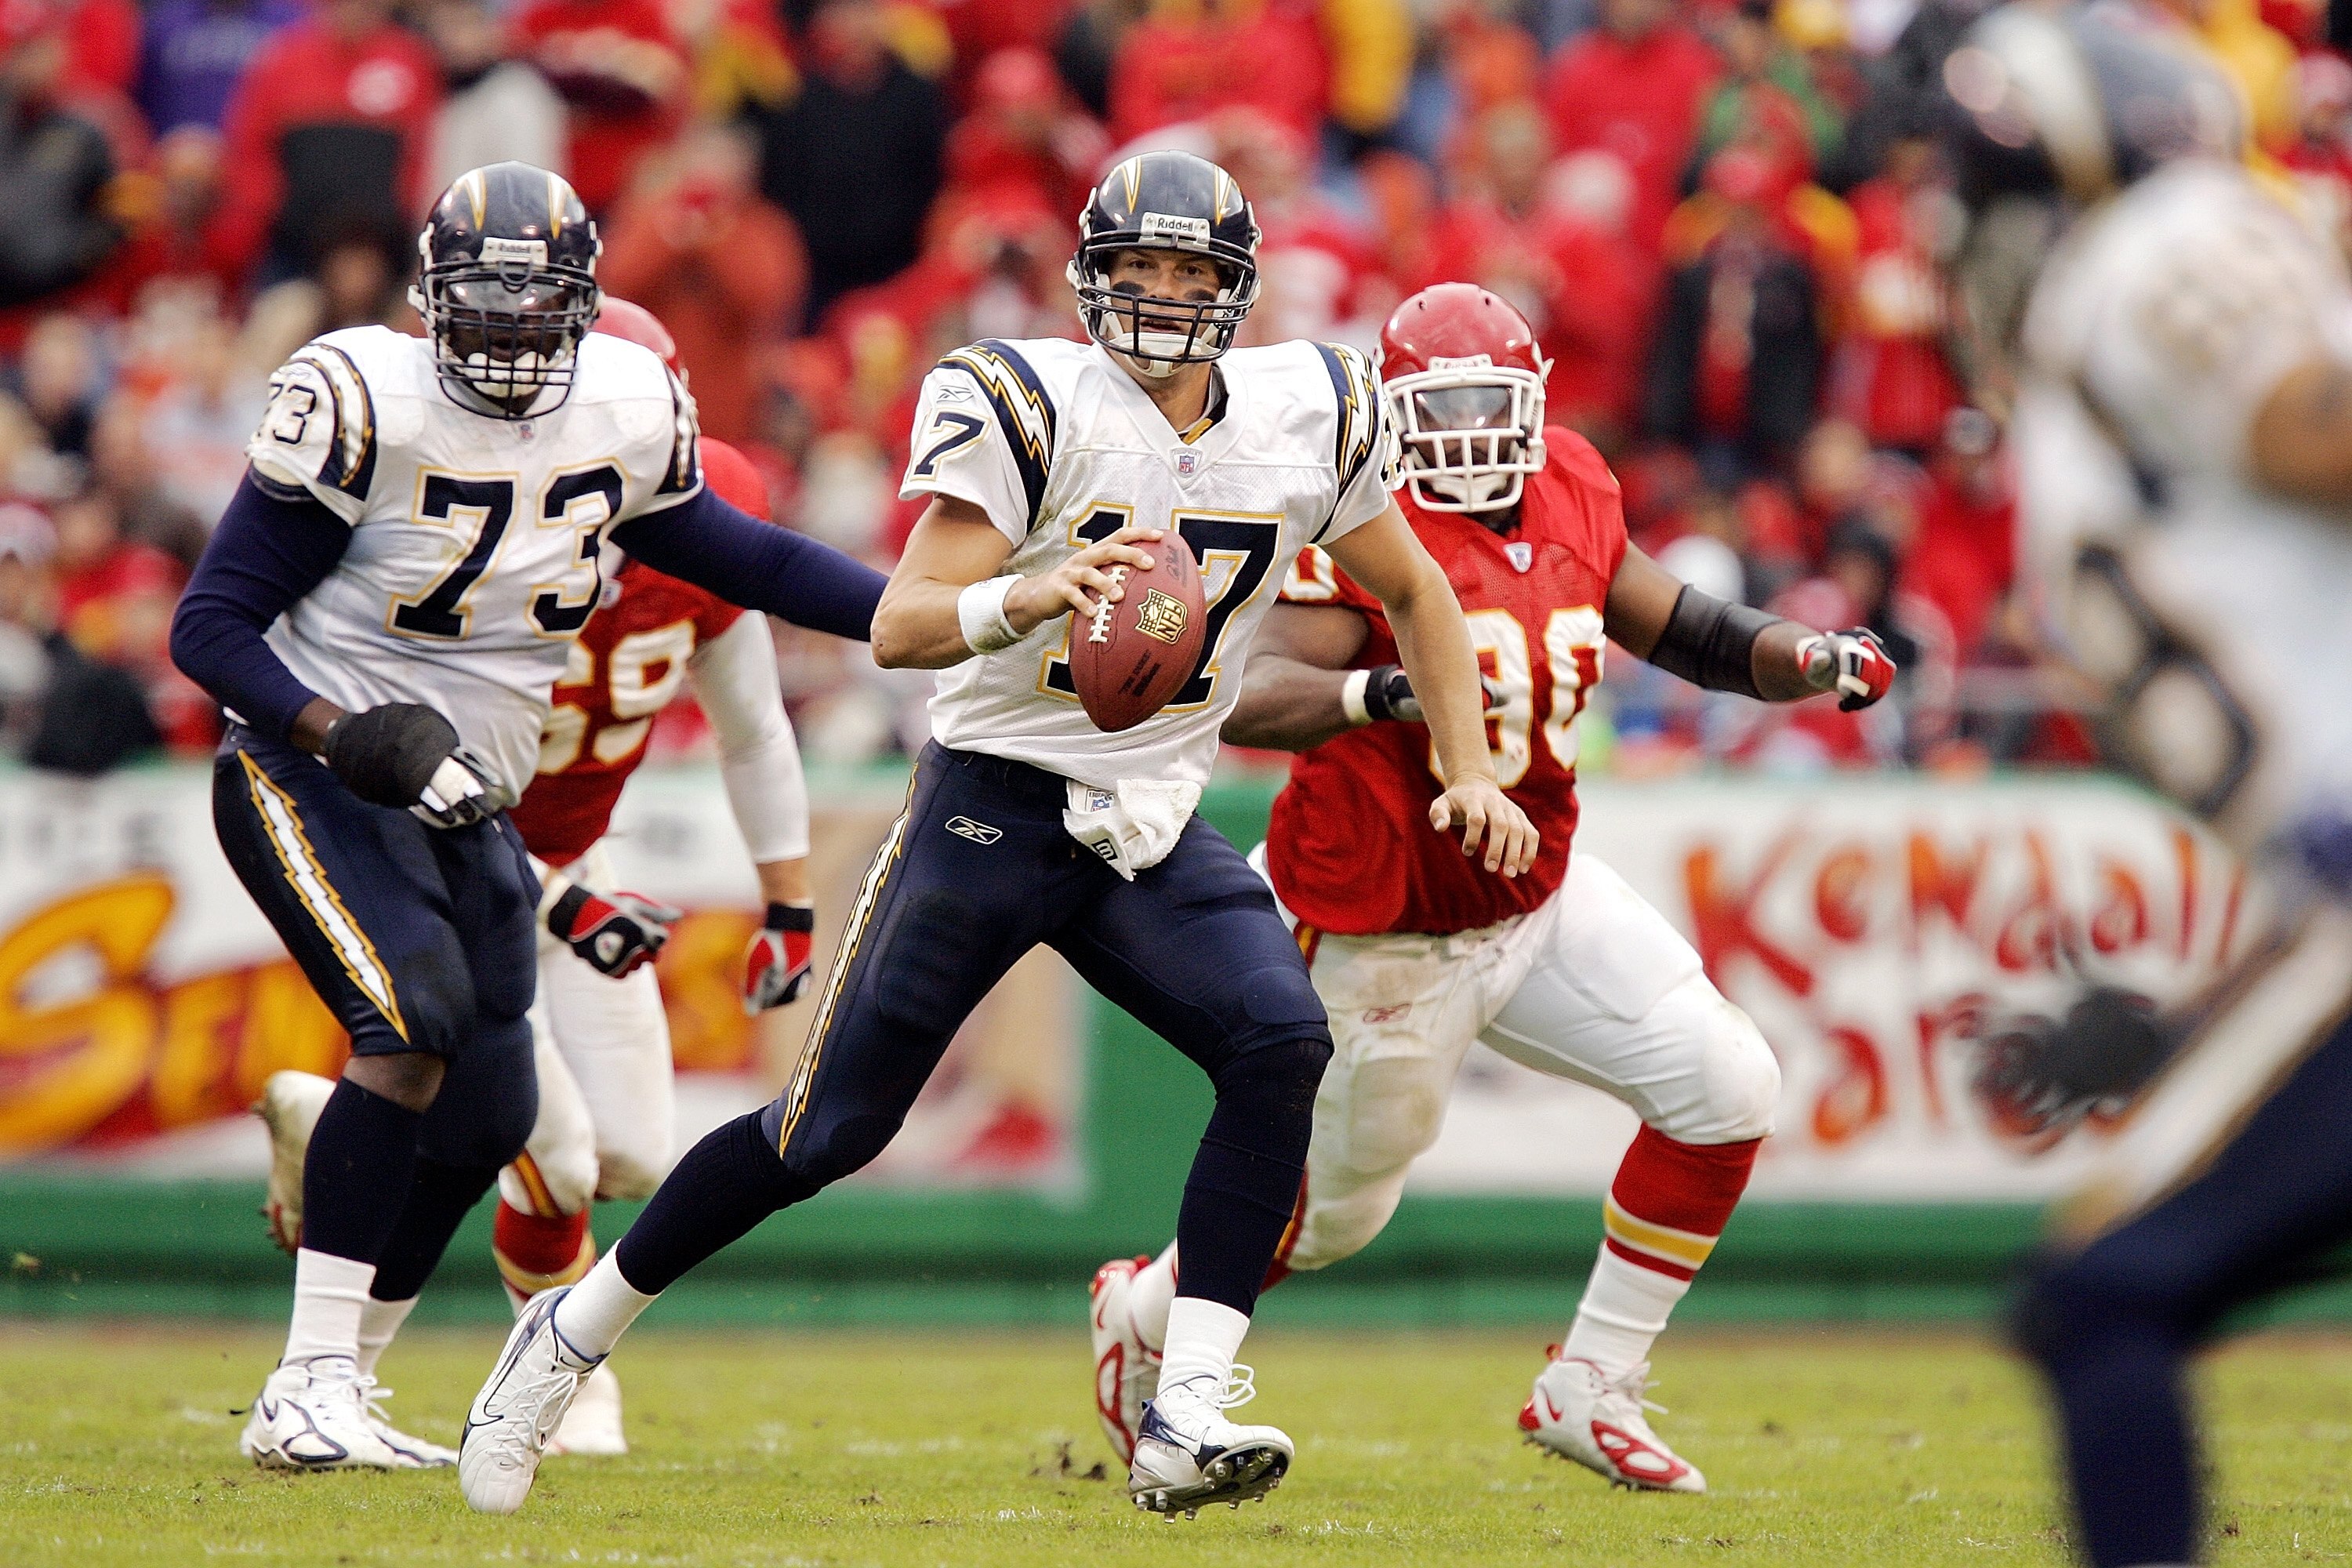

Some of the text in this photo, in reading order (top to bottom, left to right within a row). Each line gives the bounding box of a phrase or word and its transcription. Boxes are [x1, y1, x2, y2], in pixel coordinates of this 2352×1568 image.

[1156, 217, 1194, 232] Riddell
[387, 457, 631, 641] 73
[1156, 598, 1183, 641] NFL
[538, 618, 696, 774] 69
[1429, 604, 1606, 790] 90
